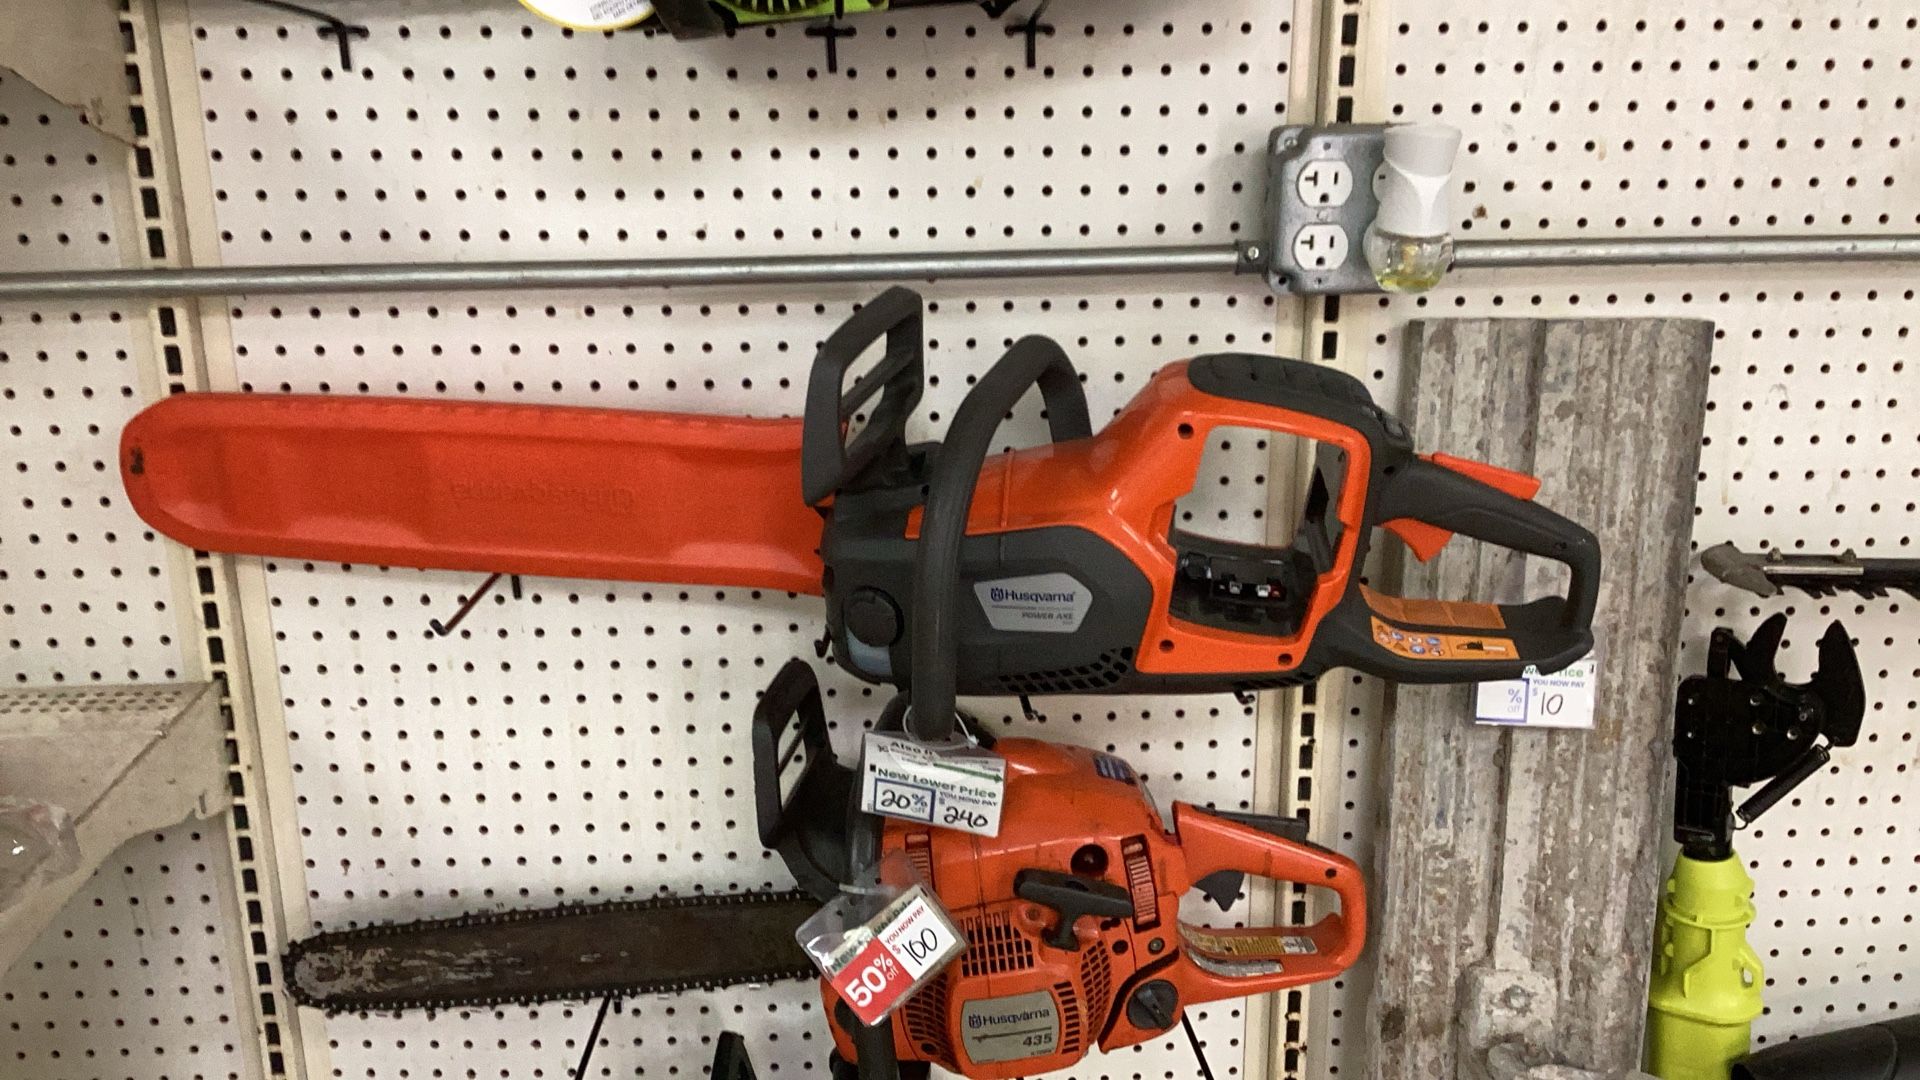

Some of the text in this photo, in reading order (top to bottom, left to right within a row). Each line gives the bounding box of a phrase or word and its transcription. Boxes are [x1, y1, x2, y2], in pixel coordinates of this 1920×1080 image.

[1005, 588, 1075, 603] Husqvarna
[1507, 687, 1563, 715] % $ 10
[1507, 704, 1521, 713] off
[878, 768, 997, 798] New Lower Price
[940, 791, 957, 799] YOU
[943, 806, 988, 828] 240
[886, 905, 924, 944] YOU NOW PAY
[831, 946, 858, 972] New
[845, 952, 893, 1007] 50%
[887, 965, 899, 980] off
[983, 1008, 1050, 1026] Husqvarna
[1022, 1033, 1053, 1047] 435
